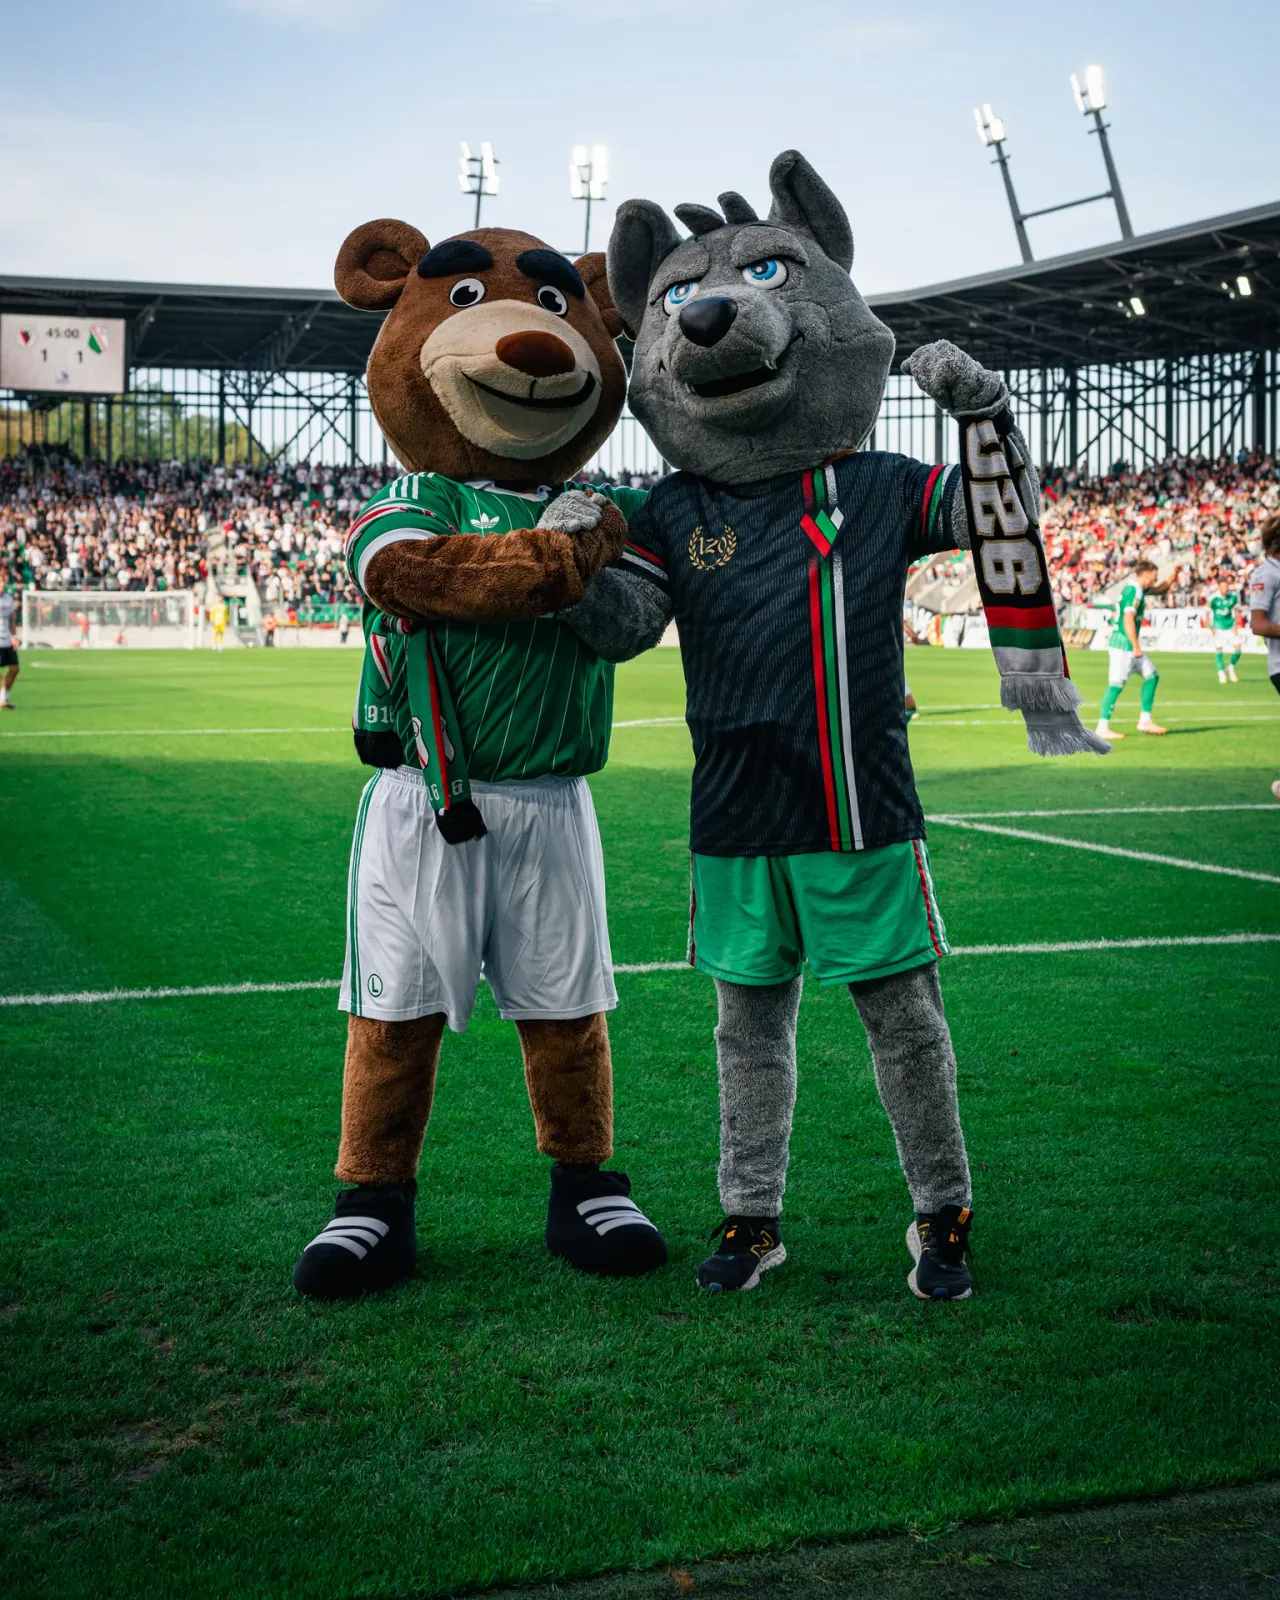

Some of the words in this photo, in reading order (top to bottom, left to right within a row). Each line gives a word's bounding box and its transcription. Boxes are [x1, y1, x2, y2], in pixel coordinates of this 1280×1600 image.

[46, 327, 80, 339] 45:00
[41, 349, 47, 362] 1
[76, 351, 83, 364] 1
[699, 536, 727, 555] 120
